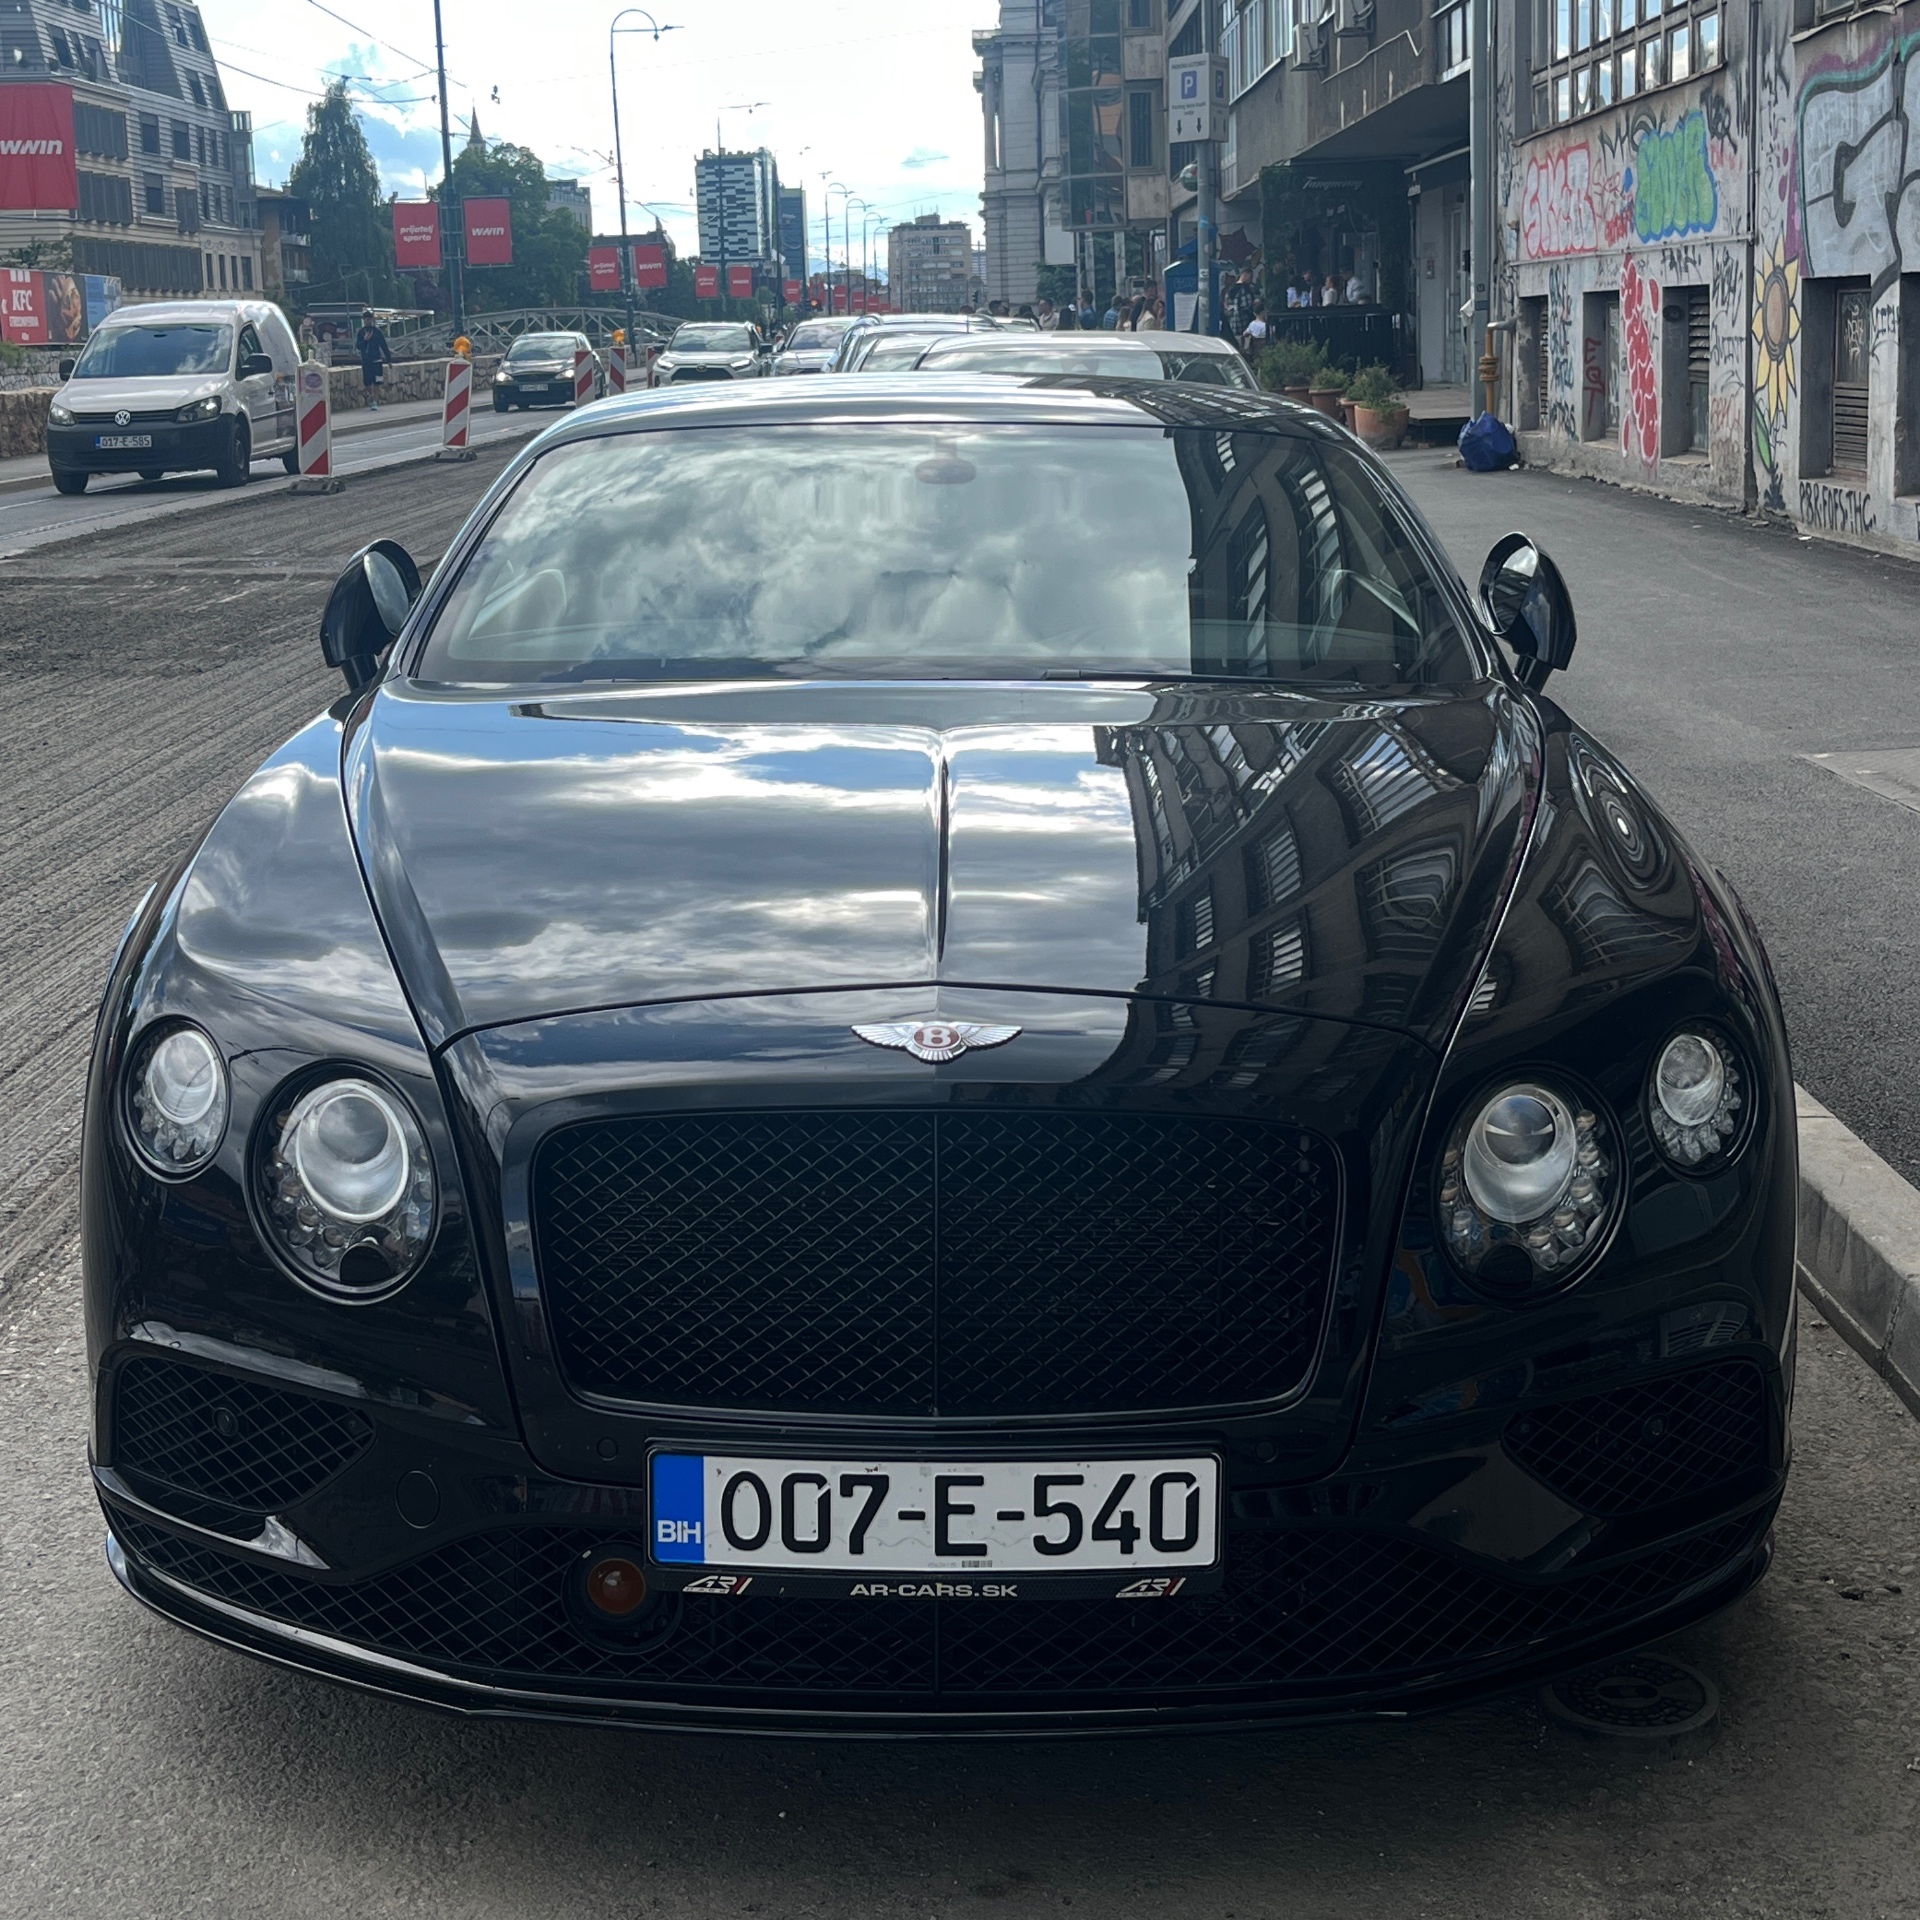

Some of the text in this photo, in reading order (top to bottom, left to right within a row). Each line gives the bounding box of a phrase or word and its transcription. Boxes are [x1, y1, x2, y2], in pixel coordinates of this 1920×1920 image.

[1184, 76, 1194, 95] P
[12, 289, 33, 311] KFC
[657, 1520, 701, 1543] BIH
[850, 1583, 1018, 1597] AR-CARS.SK
